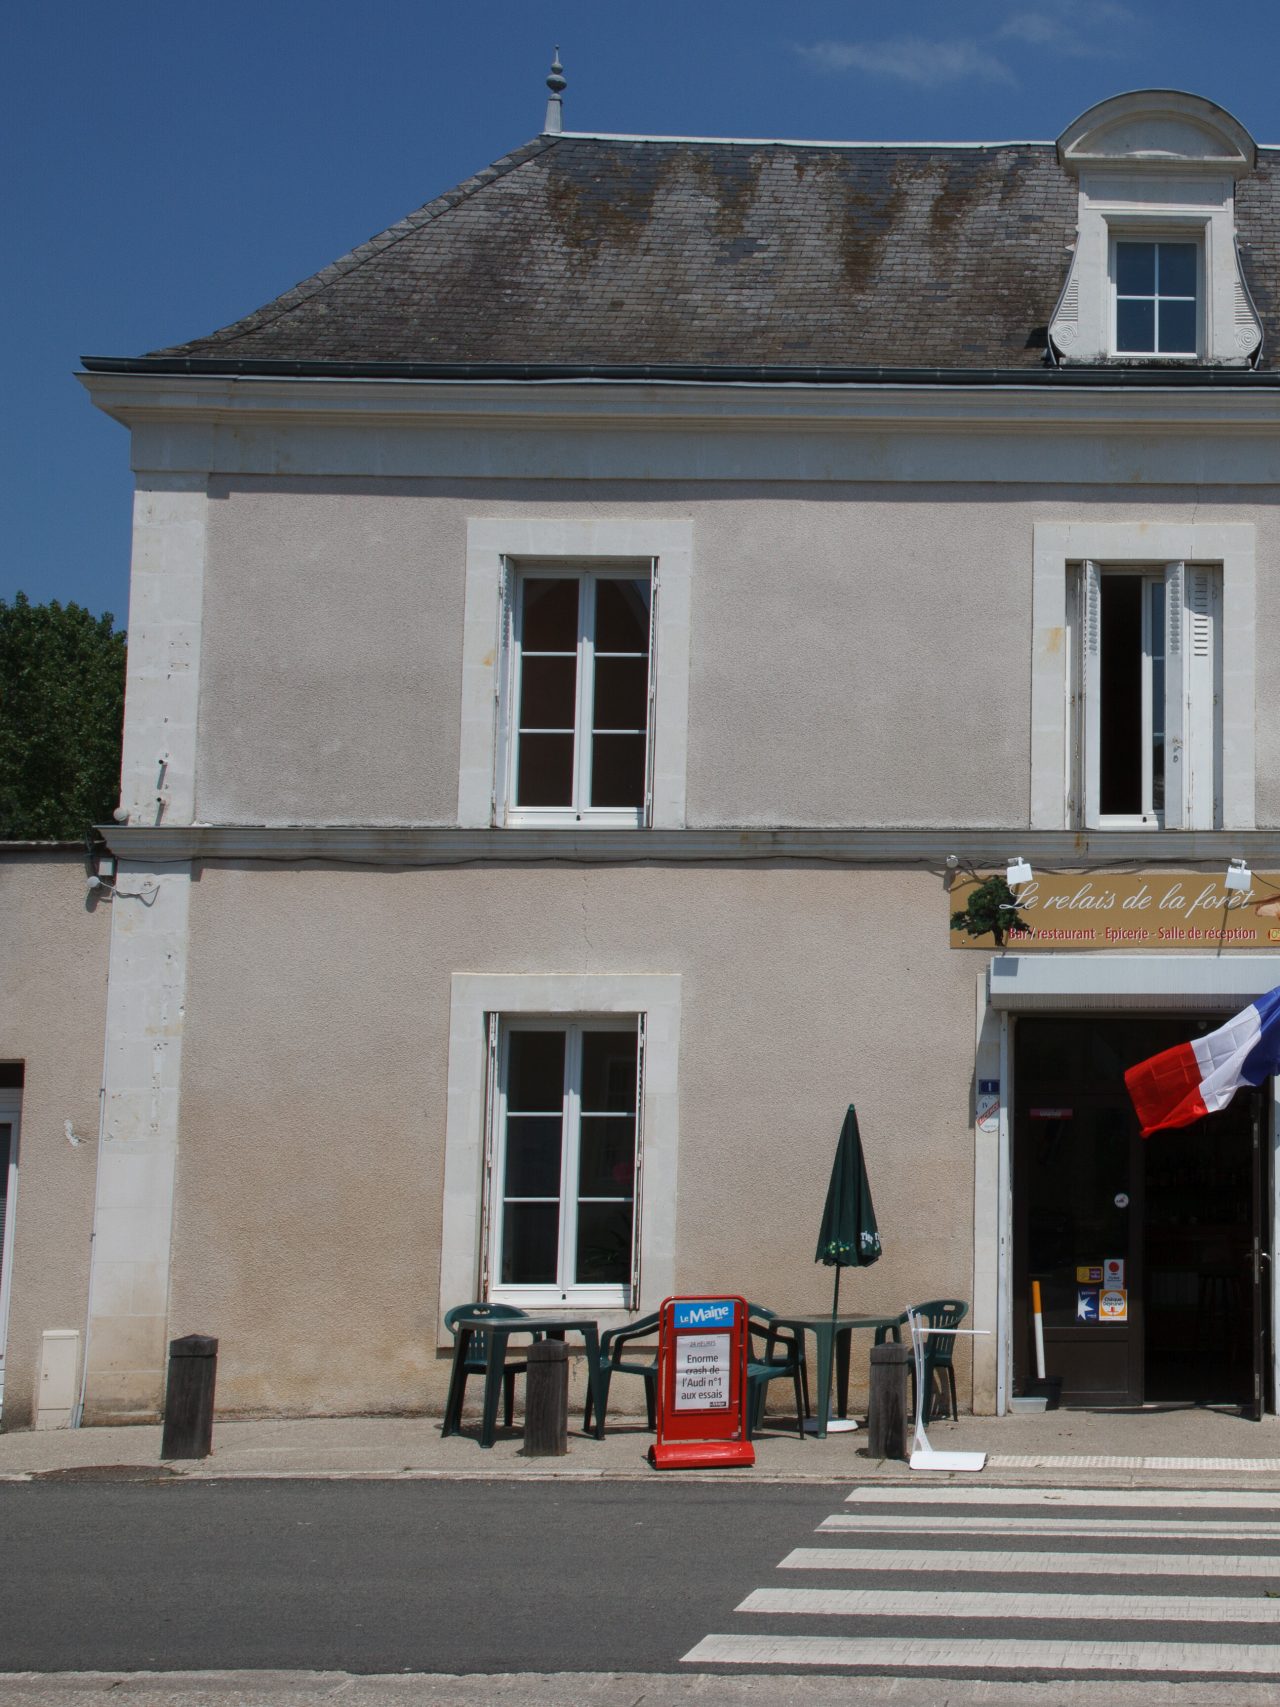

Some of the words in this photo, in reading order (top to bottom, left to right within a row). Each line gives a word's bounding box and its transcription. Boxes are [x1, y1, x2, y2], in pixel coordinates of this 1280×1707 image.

[998, 882, 1039, 910] Le
[1043, 882, 1117, 910] relais
[1122, 884, 1153, 910] de
[1158, 882, 1187, 910] la
[1184, 882, 1257, 919] forêt
[1008, 926, 1028, 941] Bar
[1037, 926, 1097, 941] restaurant
[1105, 926, 1150, 944] Epicerie
[1158, 926, 1185, 941] Salle
[1188, 926, 1203, 940] de
[1204, 926, 1258, 943] réception
[987, 1082, 992, 1092] 1
[680, 1314, 689, 1323] Le
[690, 1305, 729, 1324] Maine
[687, 1354, 719, 1364] Enorme
[685, 1365, 708, 1375] crash
[709, 1365, 720, 1375] de
[682, 1377, 706, 1388] l'Audi
[708, 1377, 722, 1387] n°1
[681, 1391, 697, 1400] aux
[698, 1389, 723, 1399] essais
